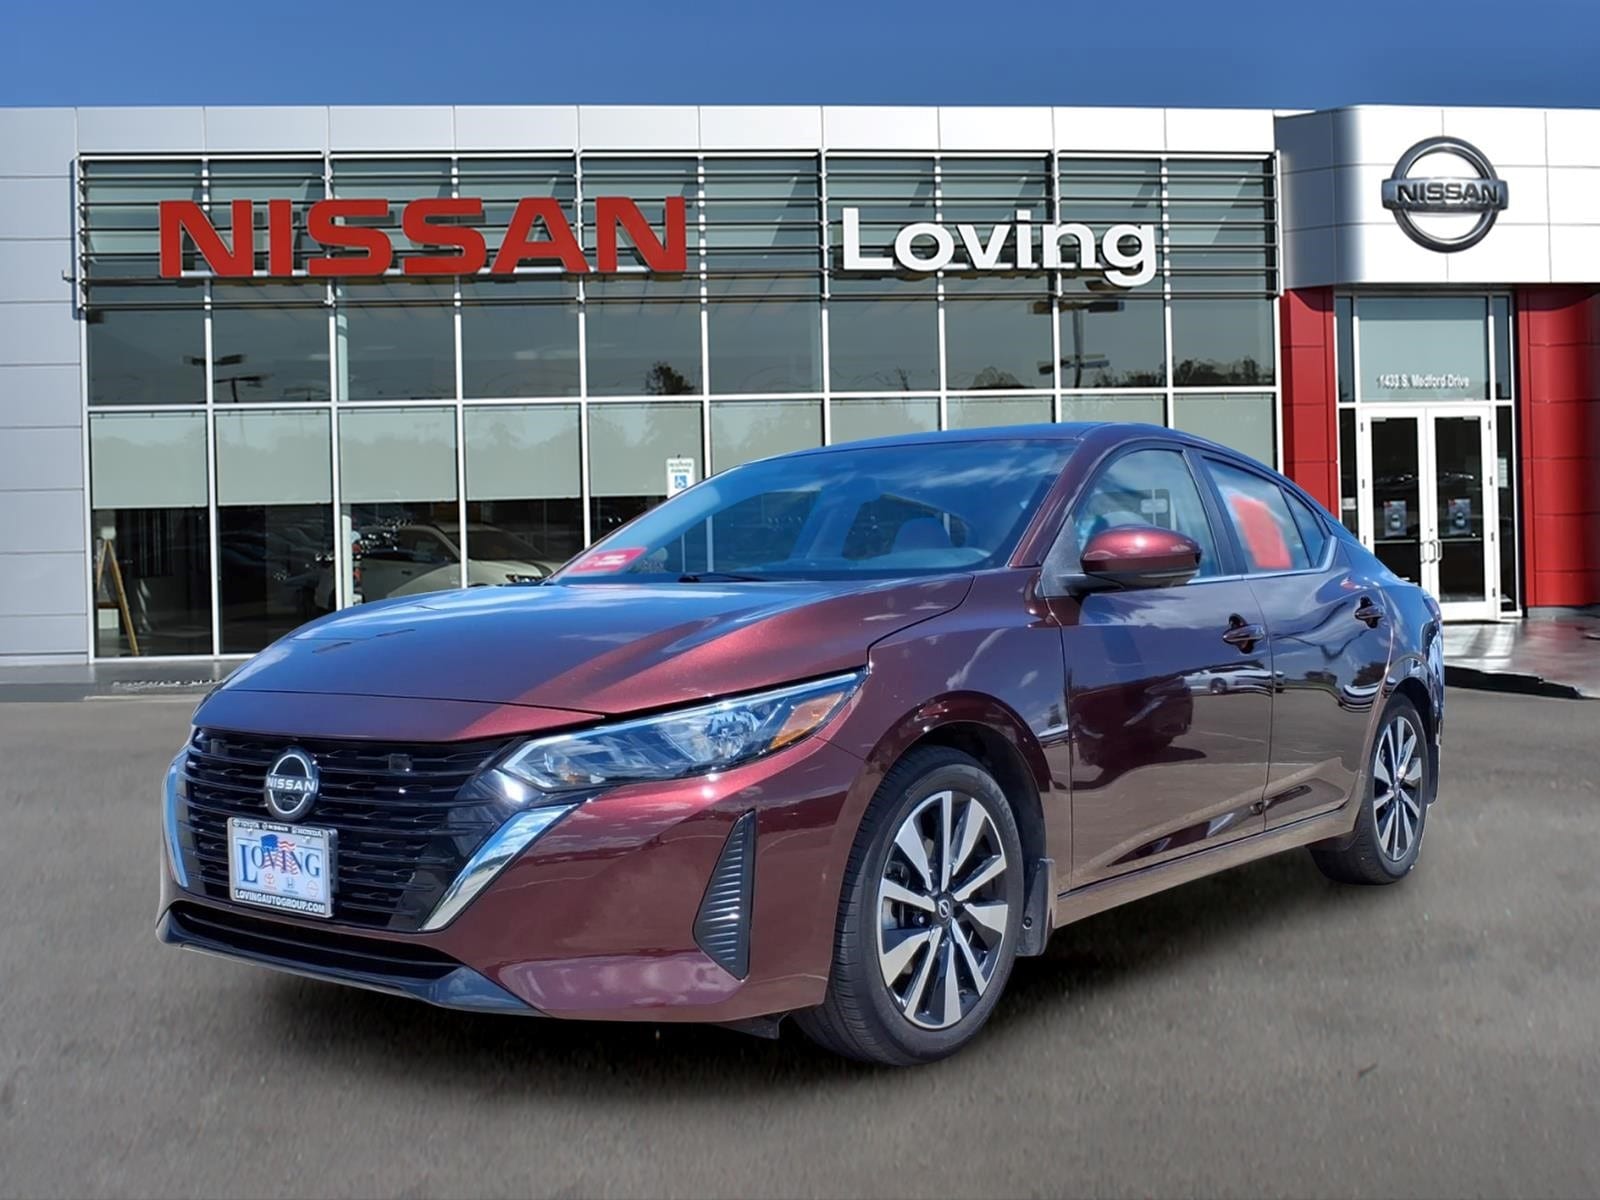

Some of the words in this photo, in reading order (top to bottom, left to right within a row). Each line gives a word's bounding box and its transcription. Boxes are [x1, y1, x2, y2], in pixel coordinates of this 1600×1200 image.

[1397, 182, 1498, 203] NISSAN
[159, 196, 687, 278] NISSAN
[842, 207, 1158, 288] Loving
[1447, 374, 1469, 387] Drive
[266, 777, 316, 792] NISSAN
[240, 844, 321, 884] LOVING
[235, 889, 326, 914] LOVINGAUTOGROUP.COM
